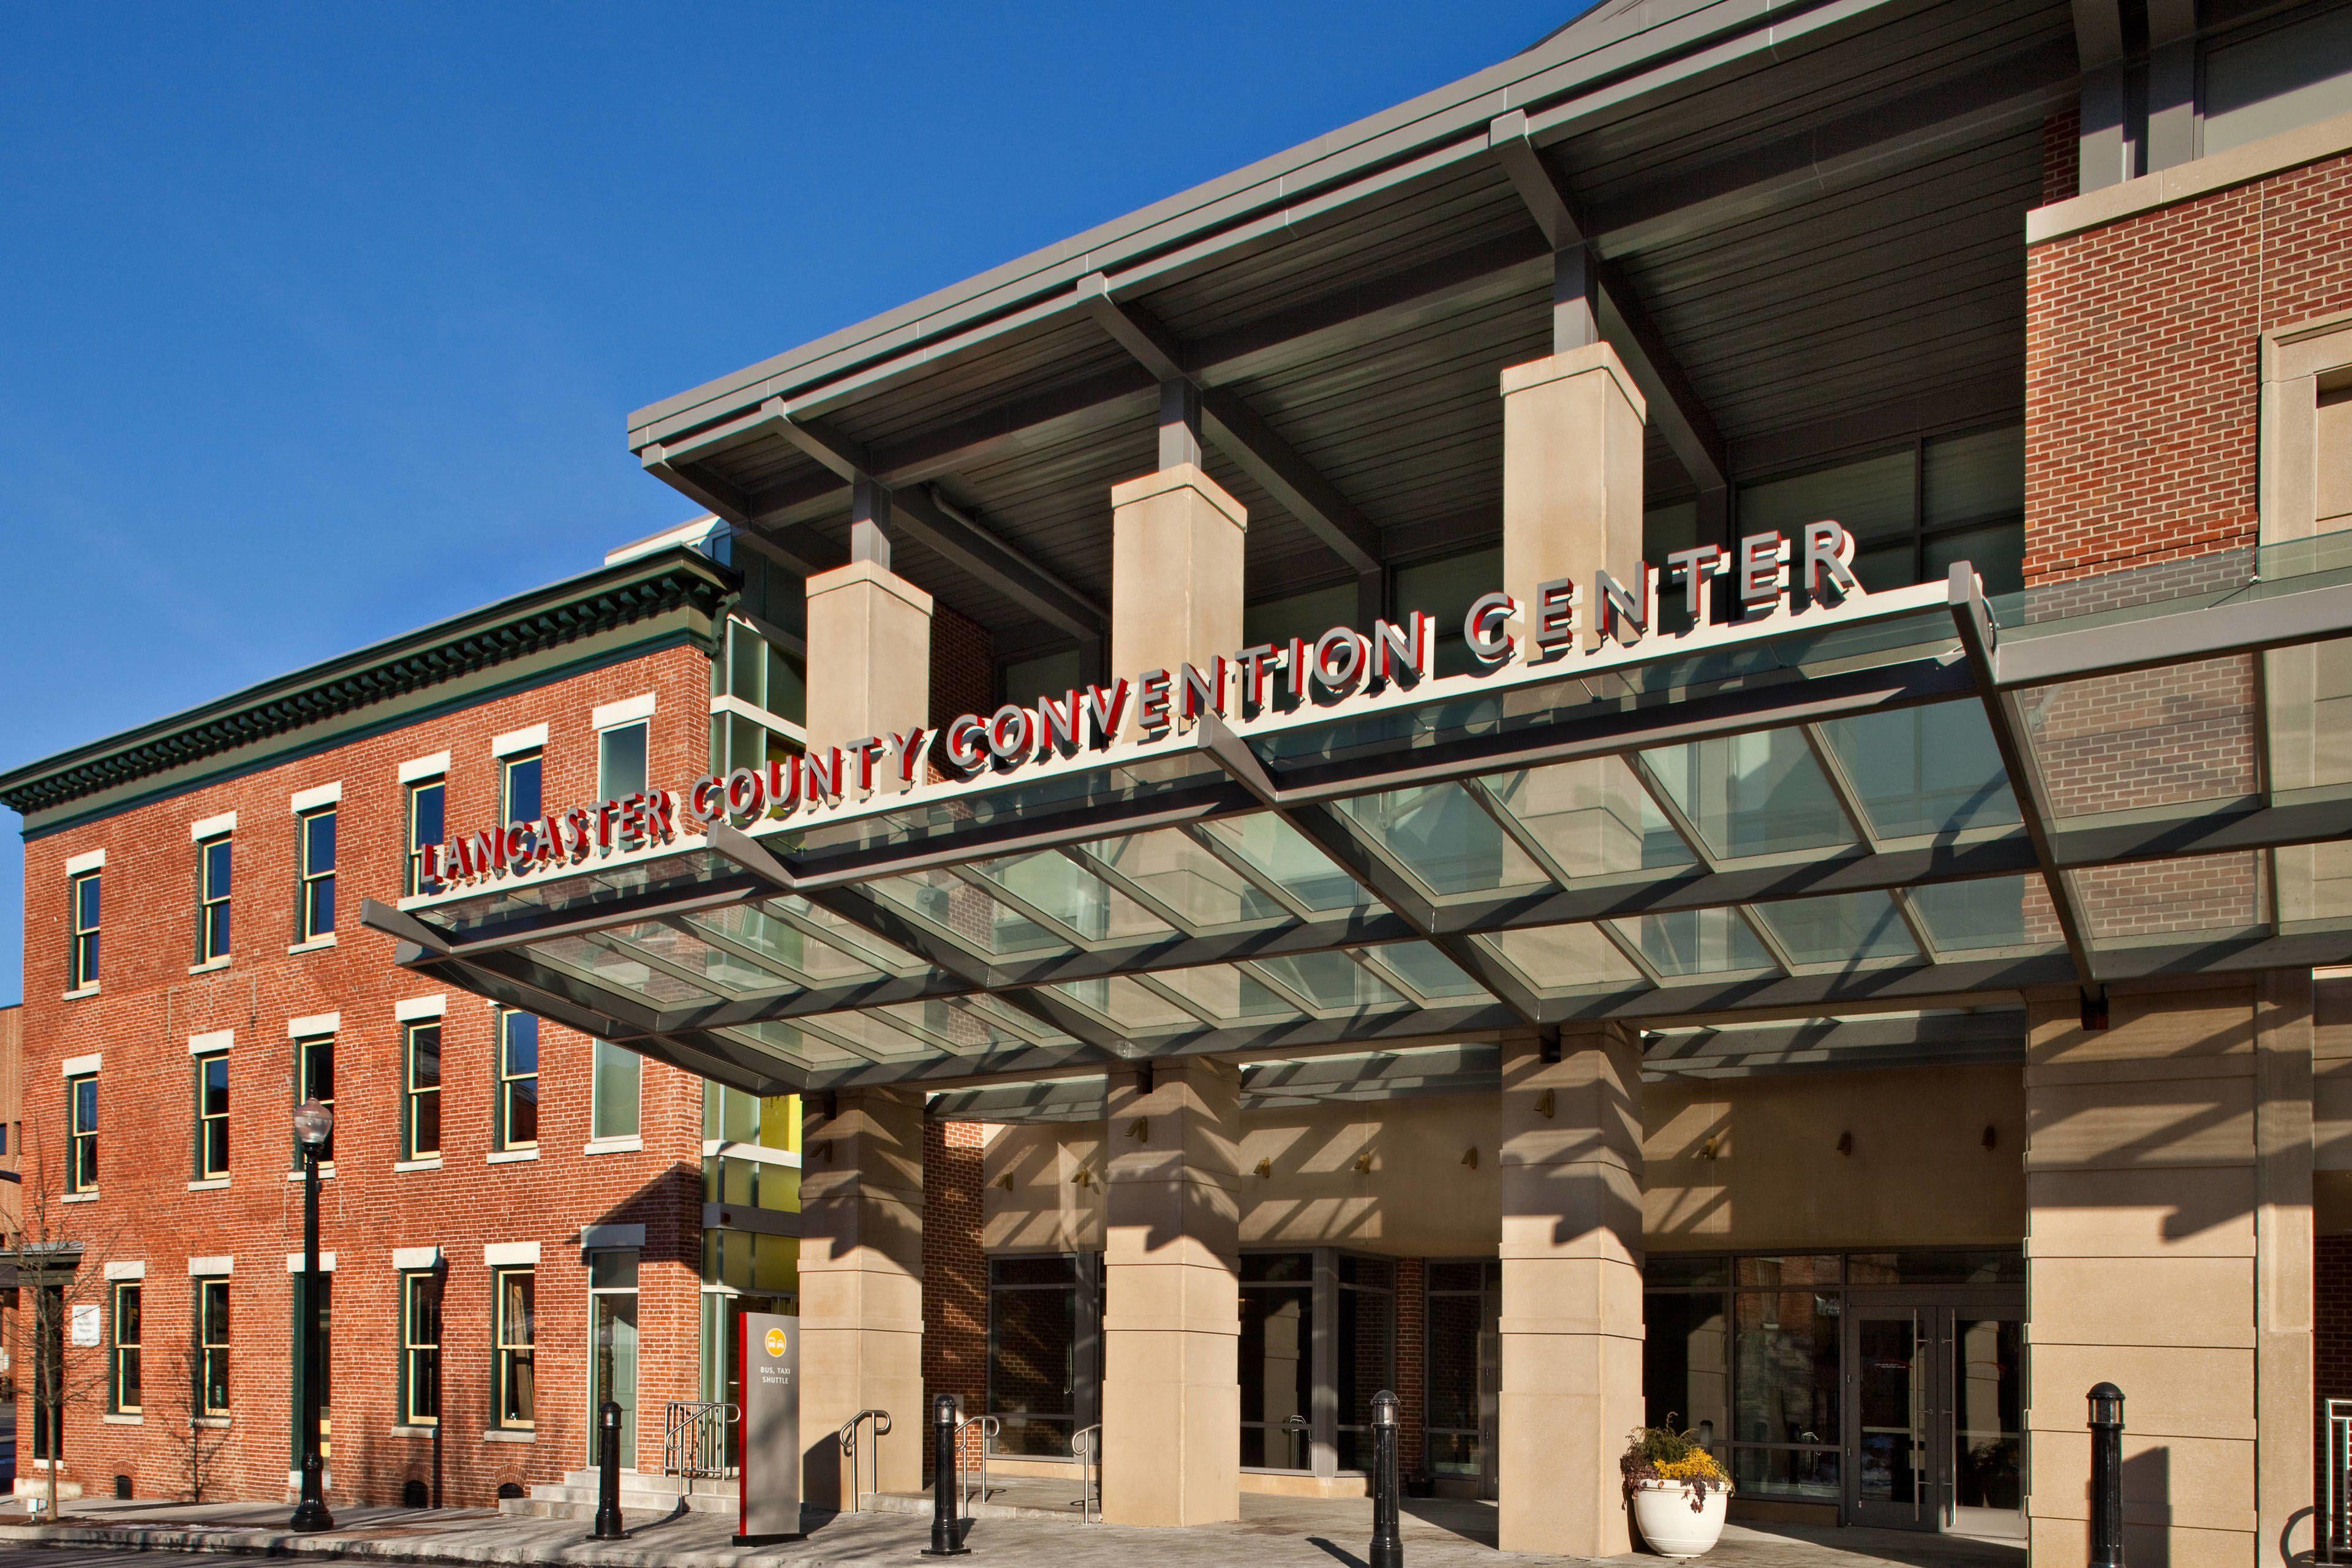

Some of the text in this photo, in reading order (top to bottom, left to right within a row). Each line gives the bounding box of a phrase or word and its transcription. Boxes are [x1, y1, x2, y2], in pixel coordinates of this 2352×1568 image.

[421, 519, 1855, 884] LANCASTER COUNTY CONVENTION CENTER
[760, 1366, 775, 1374] BUS,
[762, 1376, 789, 1384] SHUTTLE
